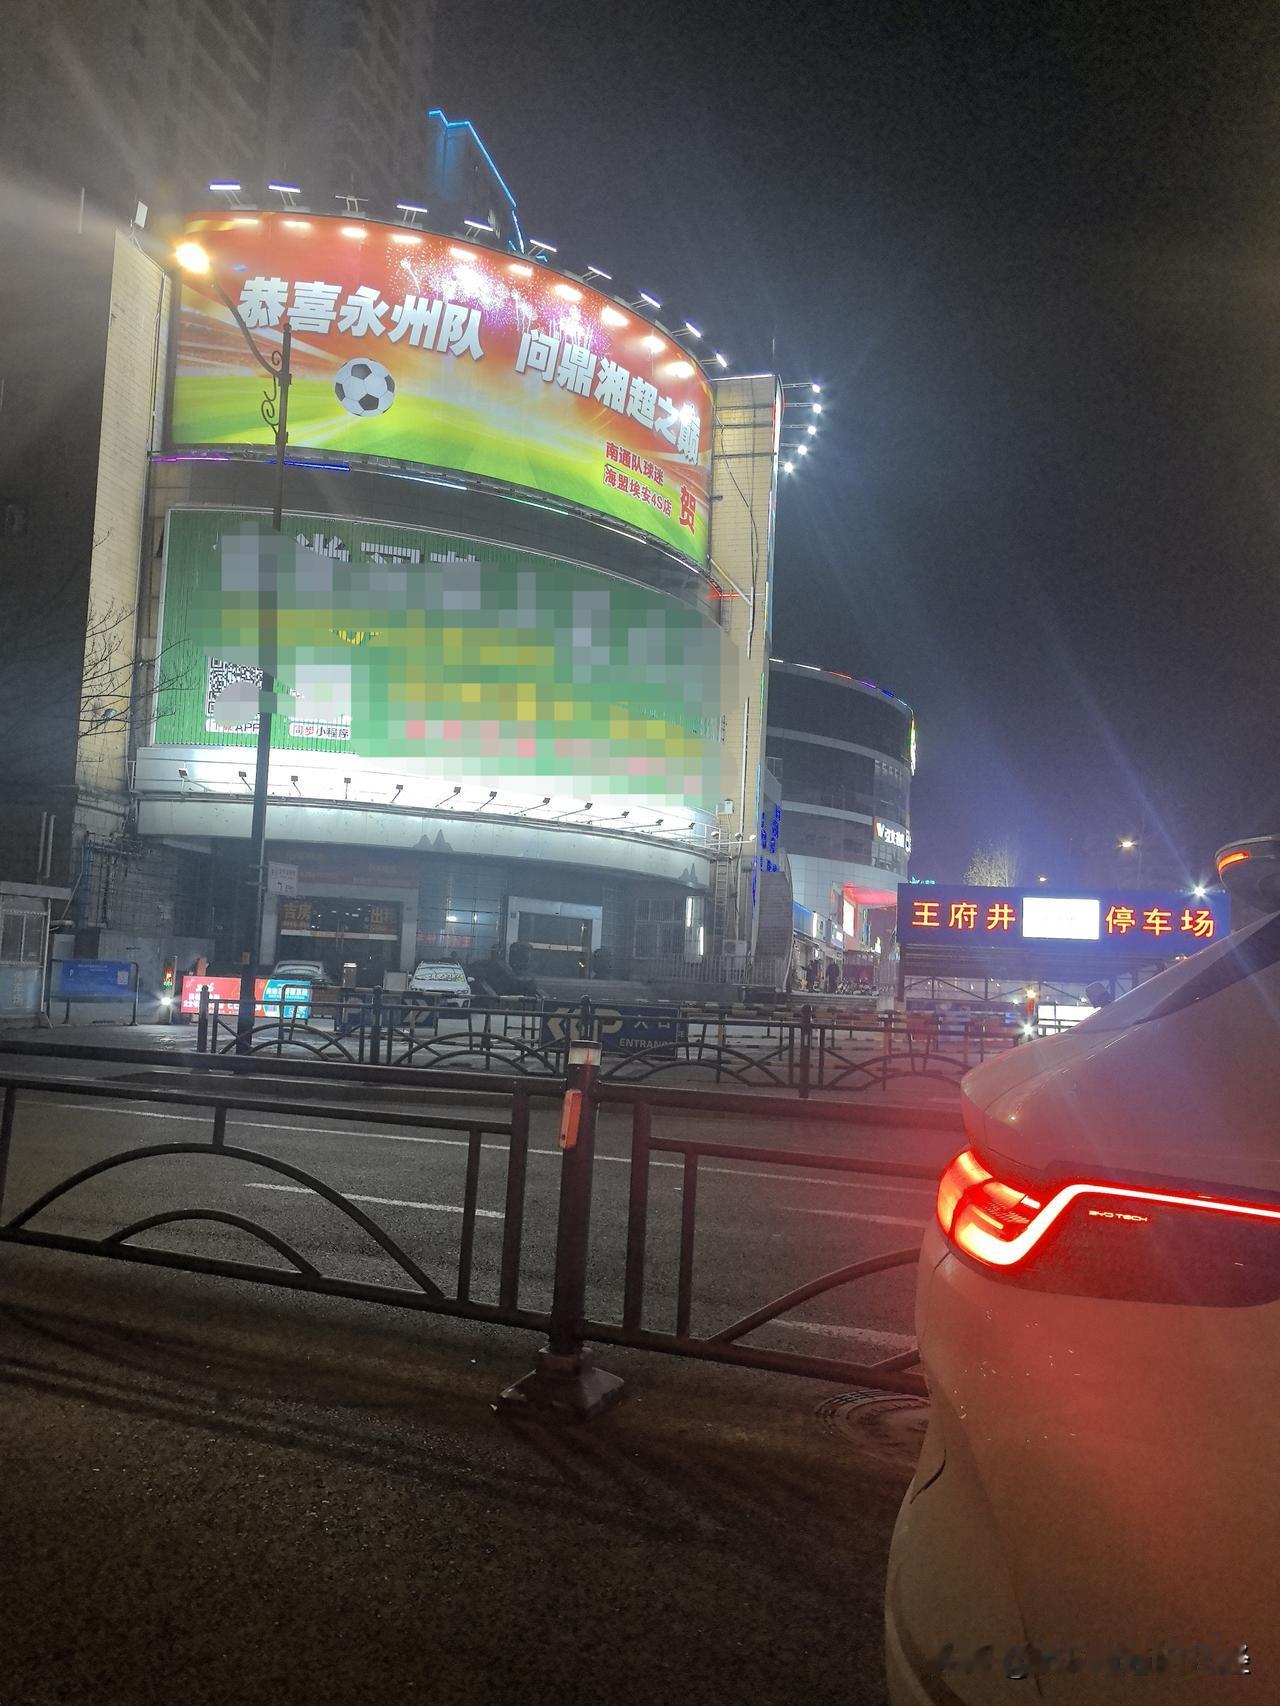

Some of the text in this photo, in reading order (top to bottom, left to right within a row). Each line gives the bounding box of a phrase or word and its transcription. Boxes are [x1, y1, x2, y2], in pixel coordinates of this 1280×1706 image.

[237, 276, 701, 465] 恭喜永州队 问鼎湘超之巅
[606, 441, 664, 487] 南通队球迷
[604, 466, 672, 518] 海盟埃安4S店
[679, 485, 697, 535] 贺
[912, 901, 1215, 938] 王府井 停车场
